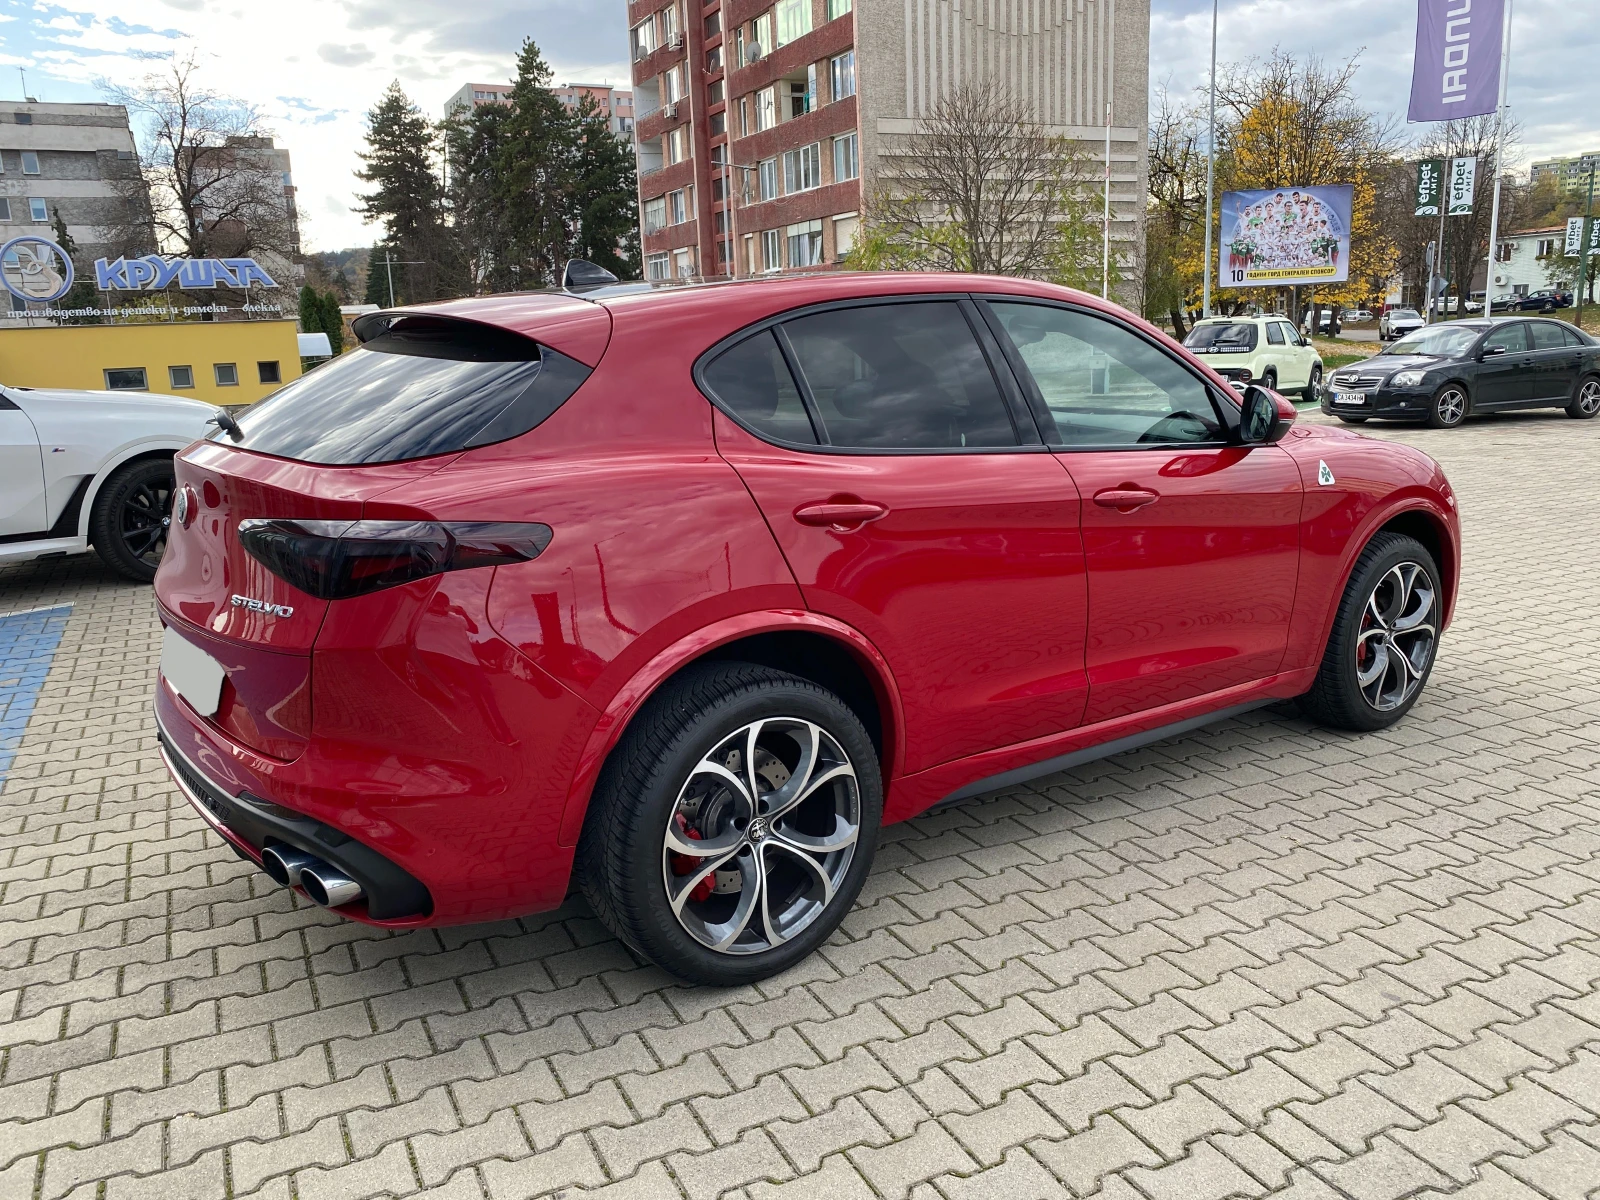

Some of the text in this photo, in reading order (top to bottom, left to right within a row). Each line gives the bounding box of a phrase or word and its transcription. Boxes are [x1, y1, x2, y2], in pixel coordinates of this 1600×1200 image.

[1418, 163, 1432, 203] efbet
[1430, 171, 1438, 195] ЛИГА
[1453, 161, 1466, 201] efbet
[1465, 169, 1473, 193] ЛИГА
[1568, 219, 1577, 247] efbet
[94, 254, 279, 291] КРУШАТА
[1230, 269, 1244, 282] 10
[7, 306, 101, 319] производство
[102, 307, 119, 316] на
[121, 304, 166, 317] детски
[170, 306, 179, 314] и
[184, 302, 228, 316] дамски
[231, 594, 294, 618] STELVIO
